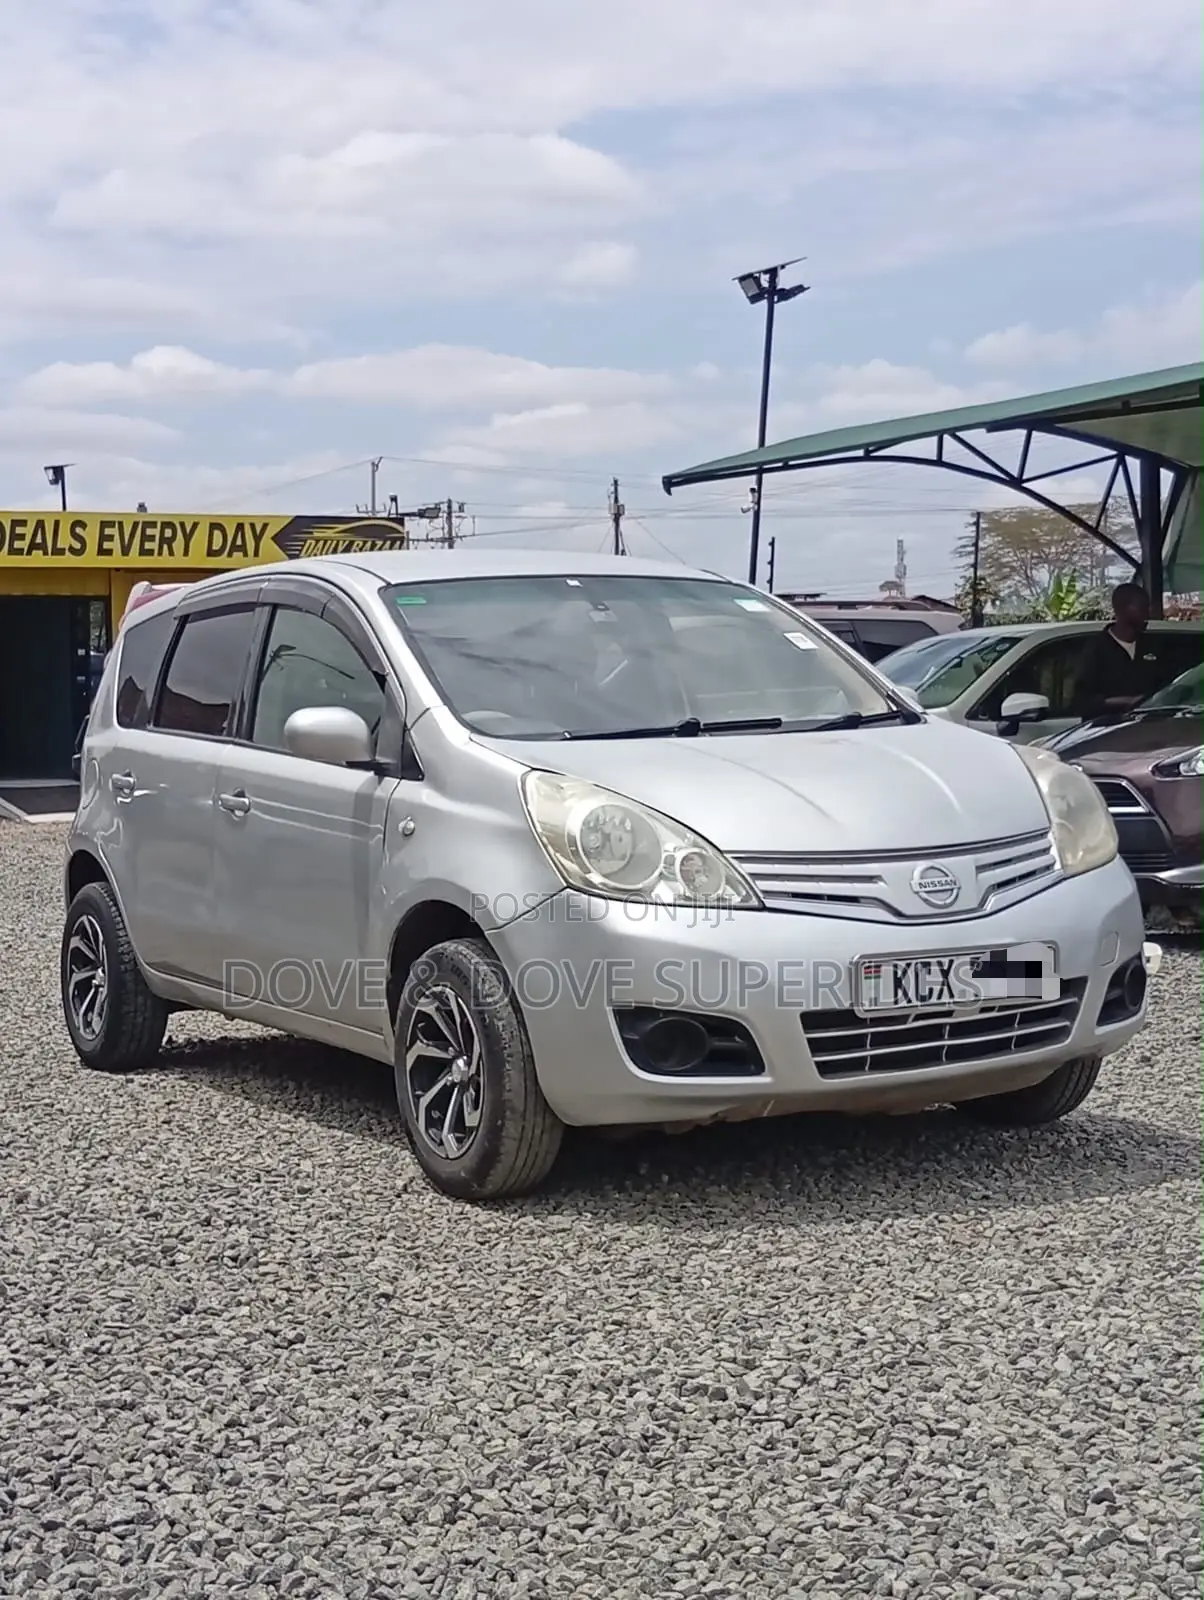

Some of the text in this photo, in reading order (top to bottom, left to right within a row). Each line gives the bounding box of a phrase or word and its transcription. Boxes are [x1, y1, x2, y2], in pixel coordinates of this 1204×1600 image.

[97, 520, 200, 557] EVERY
[206, 522, 269, 557] DAY
[918, 879, 957, 889] NISSAN
[893, 958, 955, 1005] KCX
